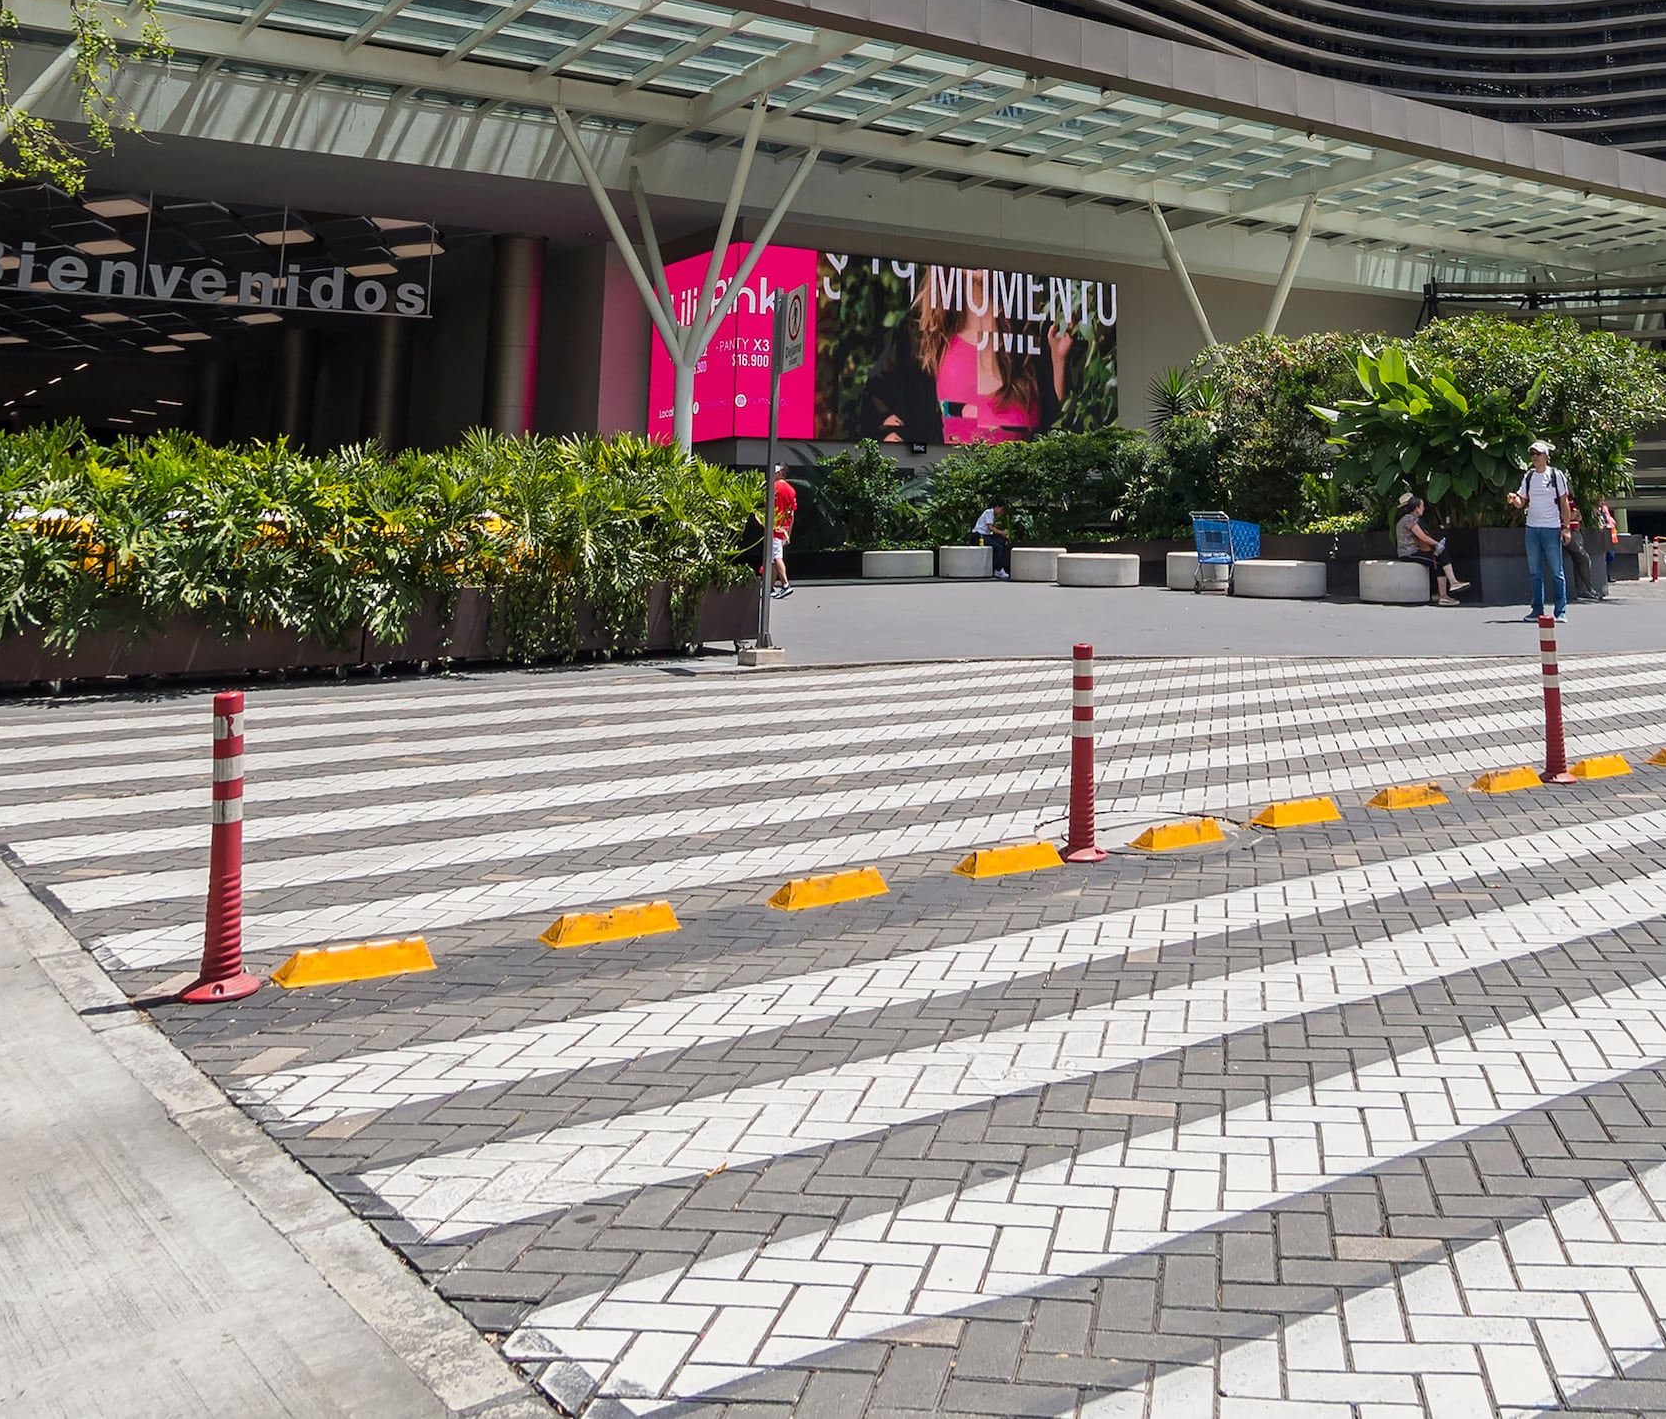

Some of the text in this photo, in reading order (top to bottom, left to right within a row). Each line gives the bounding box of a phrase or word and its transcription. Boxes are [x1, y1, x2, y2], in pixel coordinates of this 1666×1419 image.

[670, 286, 699, 327] ili
[710, 276, 776, 317] Pnk
[753, 338, 770, 352] X3
[731, 353, 770, 368] $16.900
